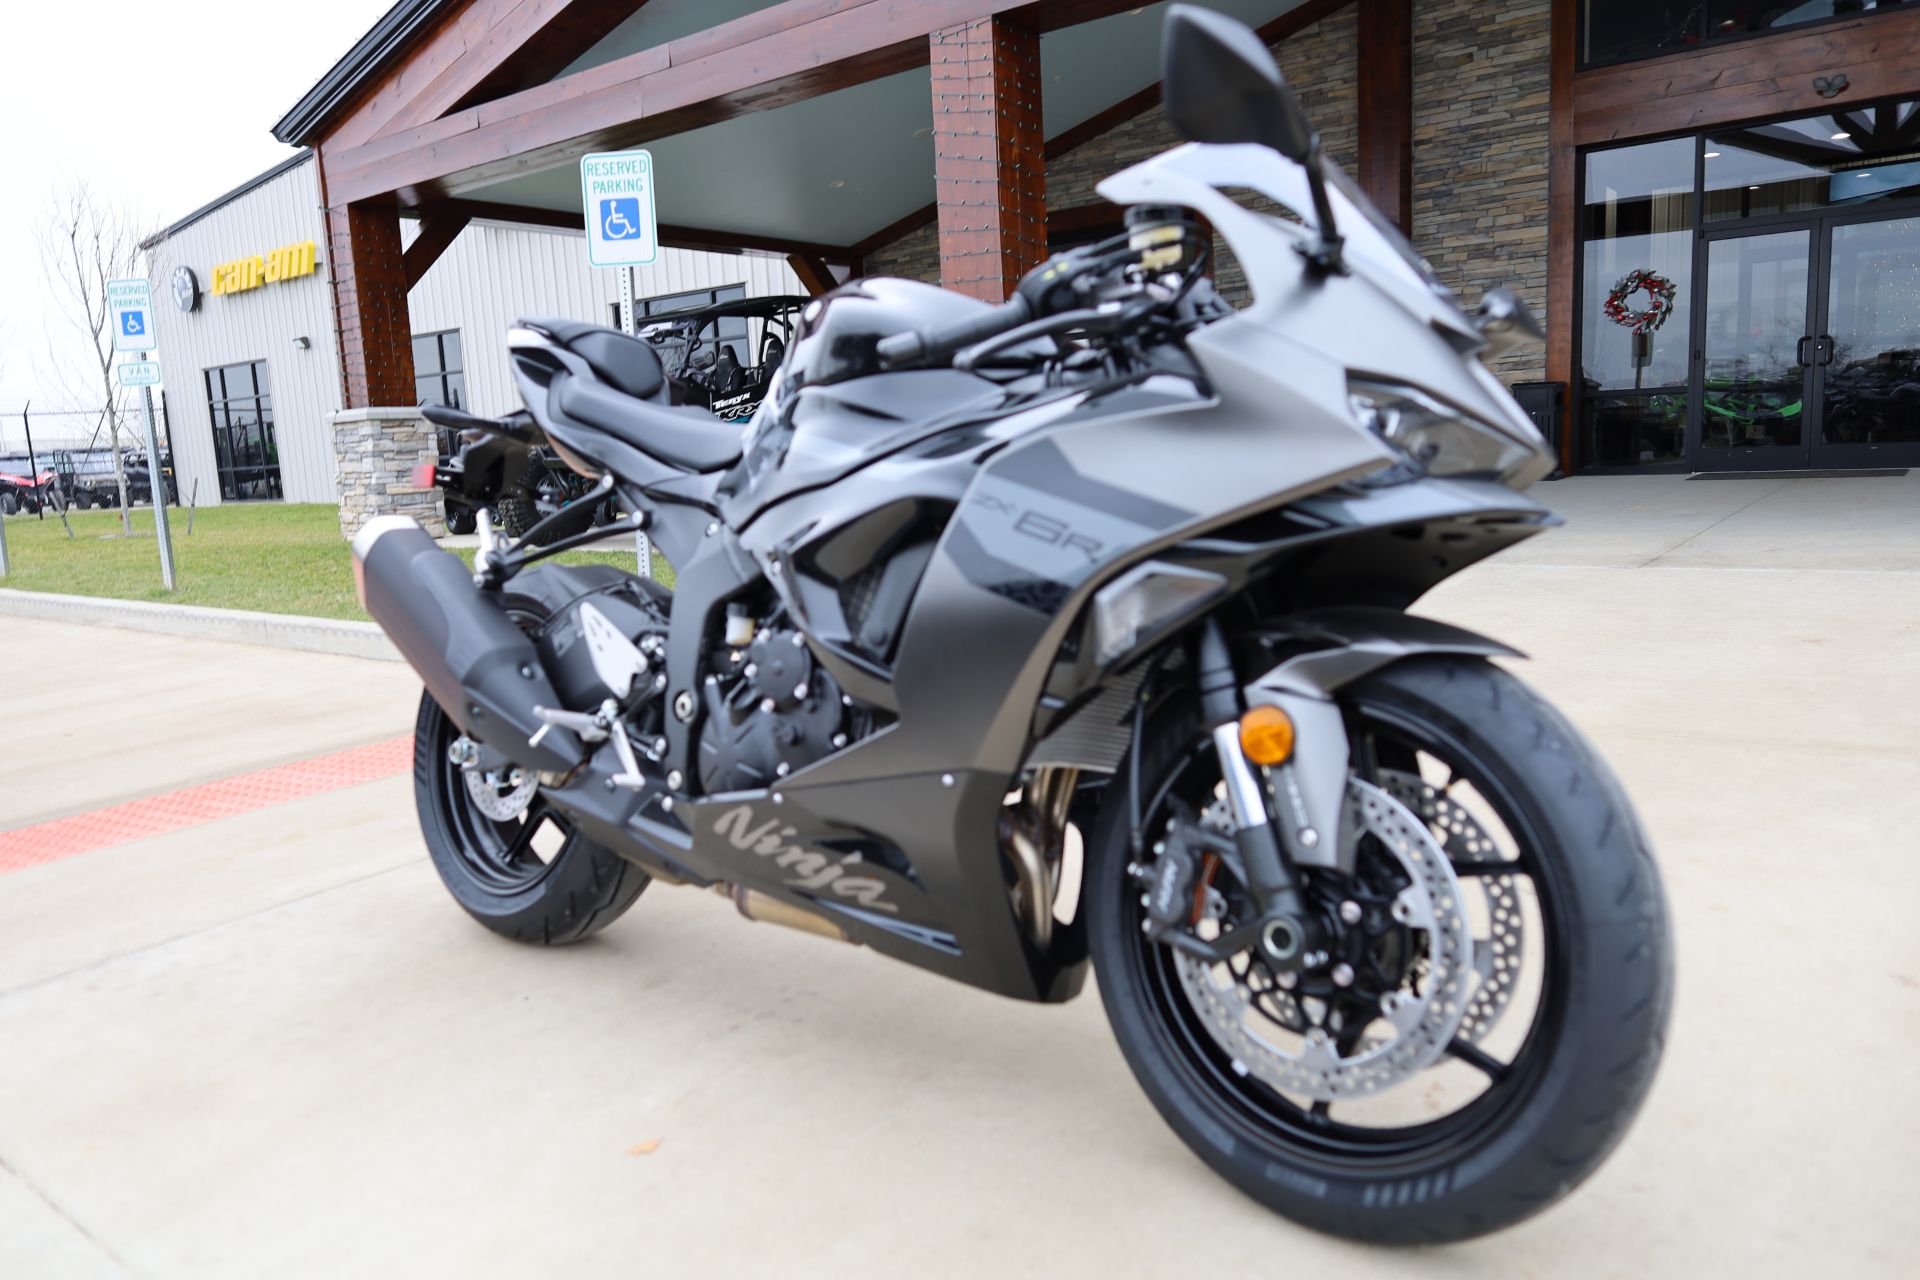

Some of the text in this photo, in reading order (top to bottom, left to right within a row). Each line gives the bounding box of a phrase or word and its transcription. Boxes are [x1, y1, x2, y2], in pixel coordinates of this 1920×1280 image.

[586, 159, 647, 177] RESERVED
[592, 178, 643, 195] PARKING
[110, 284, 148, 297] RESERVED
[113, 297, 147, 309] PARKING
[128, 366, 150, 376] VAN
[713, 805, 898, 913] Ninja
